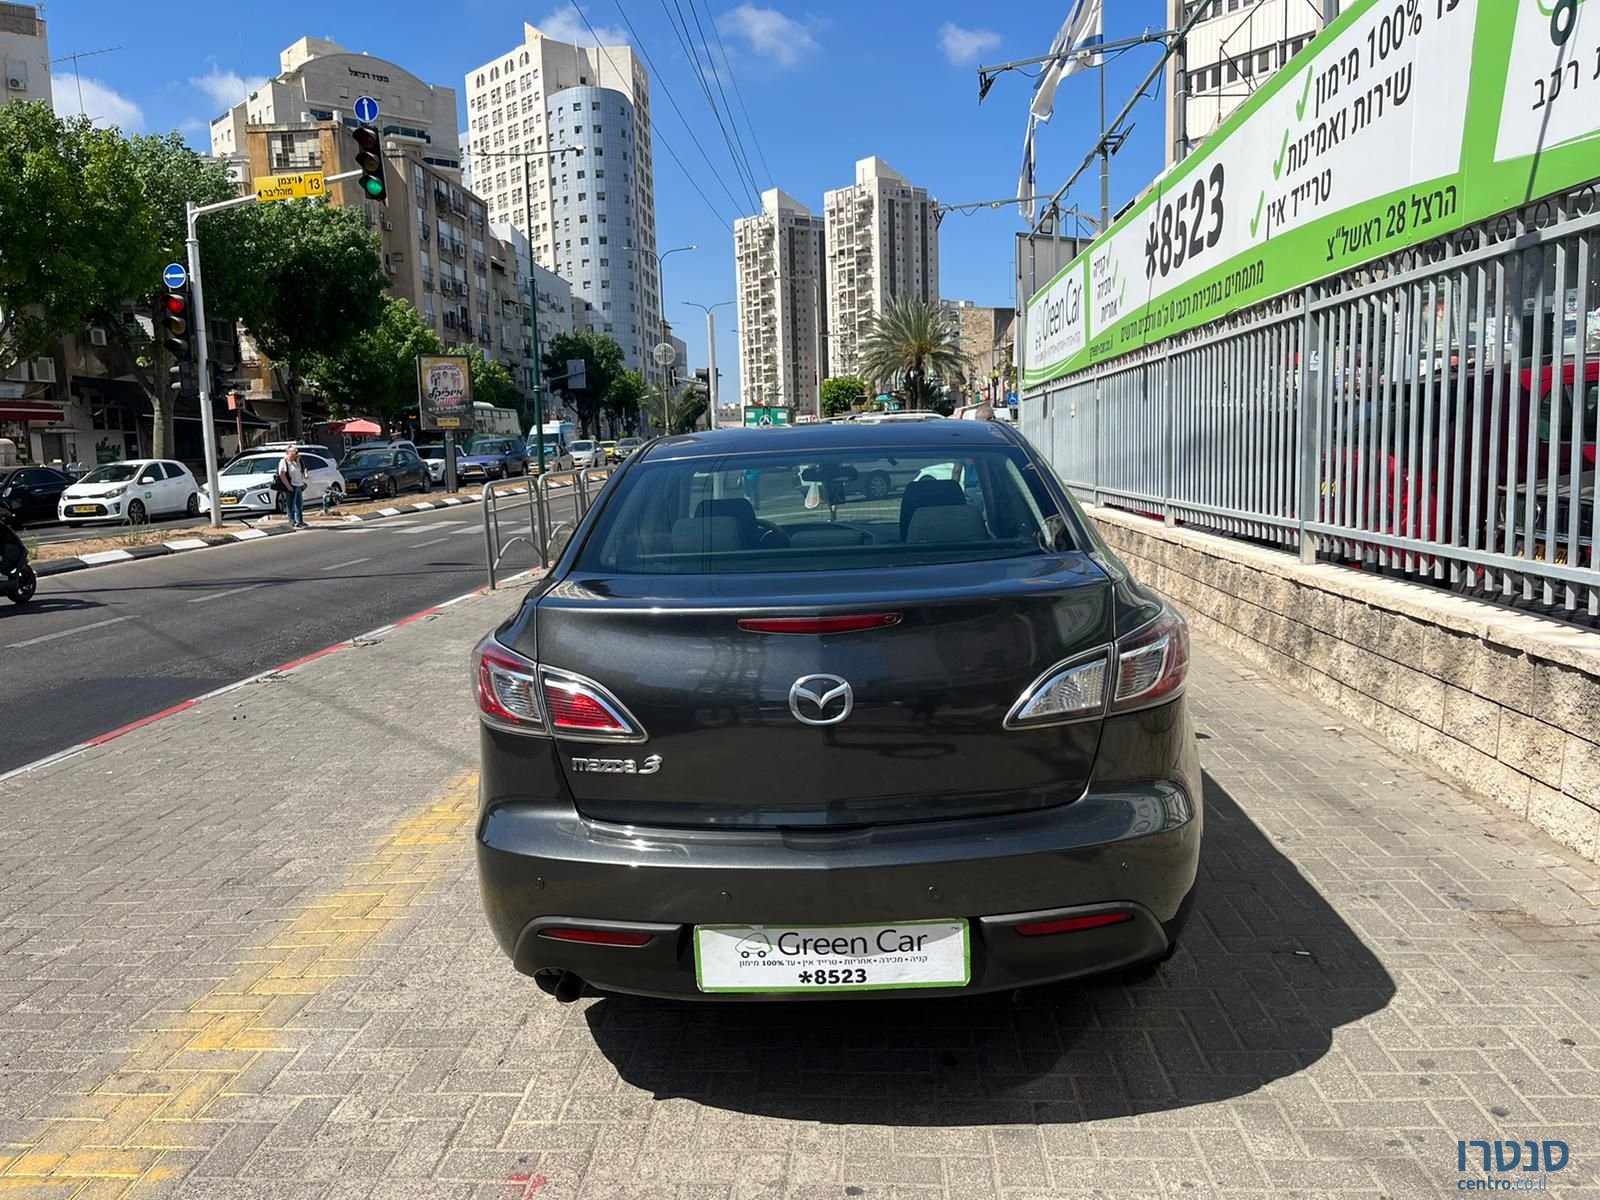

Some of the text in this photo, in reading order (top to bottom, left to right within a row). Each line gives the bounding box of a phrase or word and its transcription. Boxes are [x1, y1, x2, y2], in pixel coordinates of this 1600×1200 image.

[1314, 0, 1423, 119] 100% מימון
[1532, 60, 1579, 111] רכב
[1286, 61, 1413, 177] שירות ואמינות
[263, 187, 293, 197] מוהליבר
[278, 176, 298, 187] ויצמן
[308, 178, 320, 190] 13
[1266, 167, 1332, 241] טרייד אין
[1386, 200, 1406, 238] 28
[1411, 185, 1457, 228] הרצל
[1192, 281, 1222, 313] במכירת
[1224, 259, 1264, 298] מתמחים
[1042, 278, 1082, 341] Green Car
[638, 753, 663, 774] 3
[739, 955, 928, 968] קניה מכירה אחריות טרייד אין עד 100% מימון
[777, 929, 928, 956] Green Car
